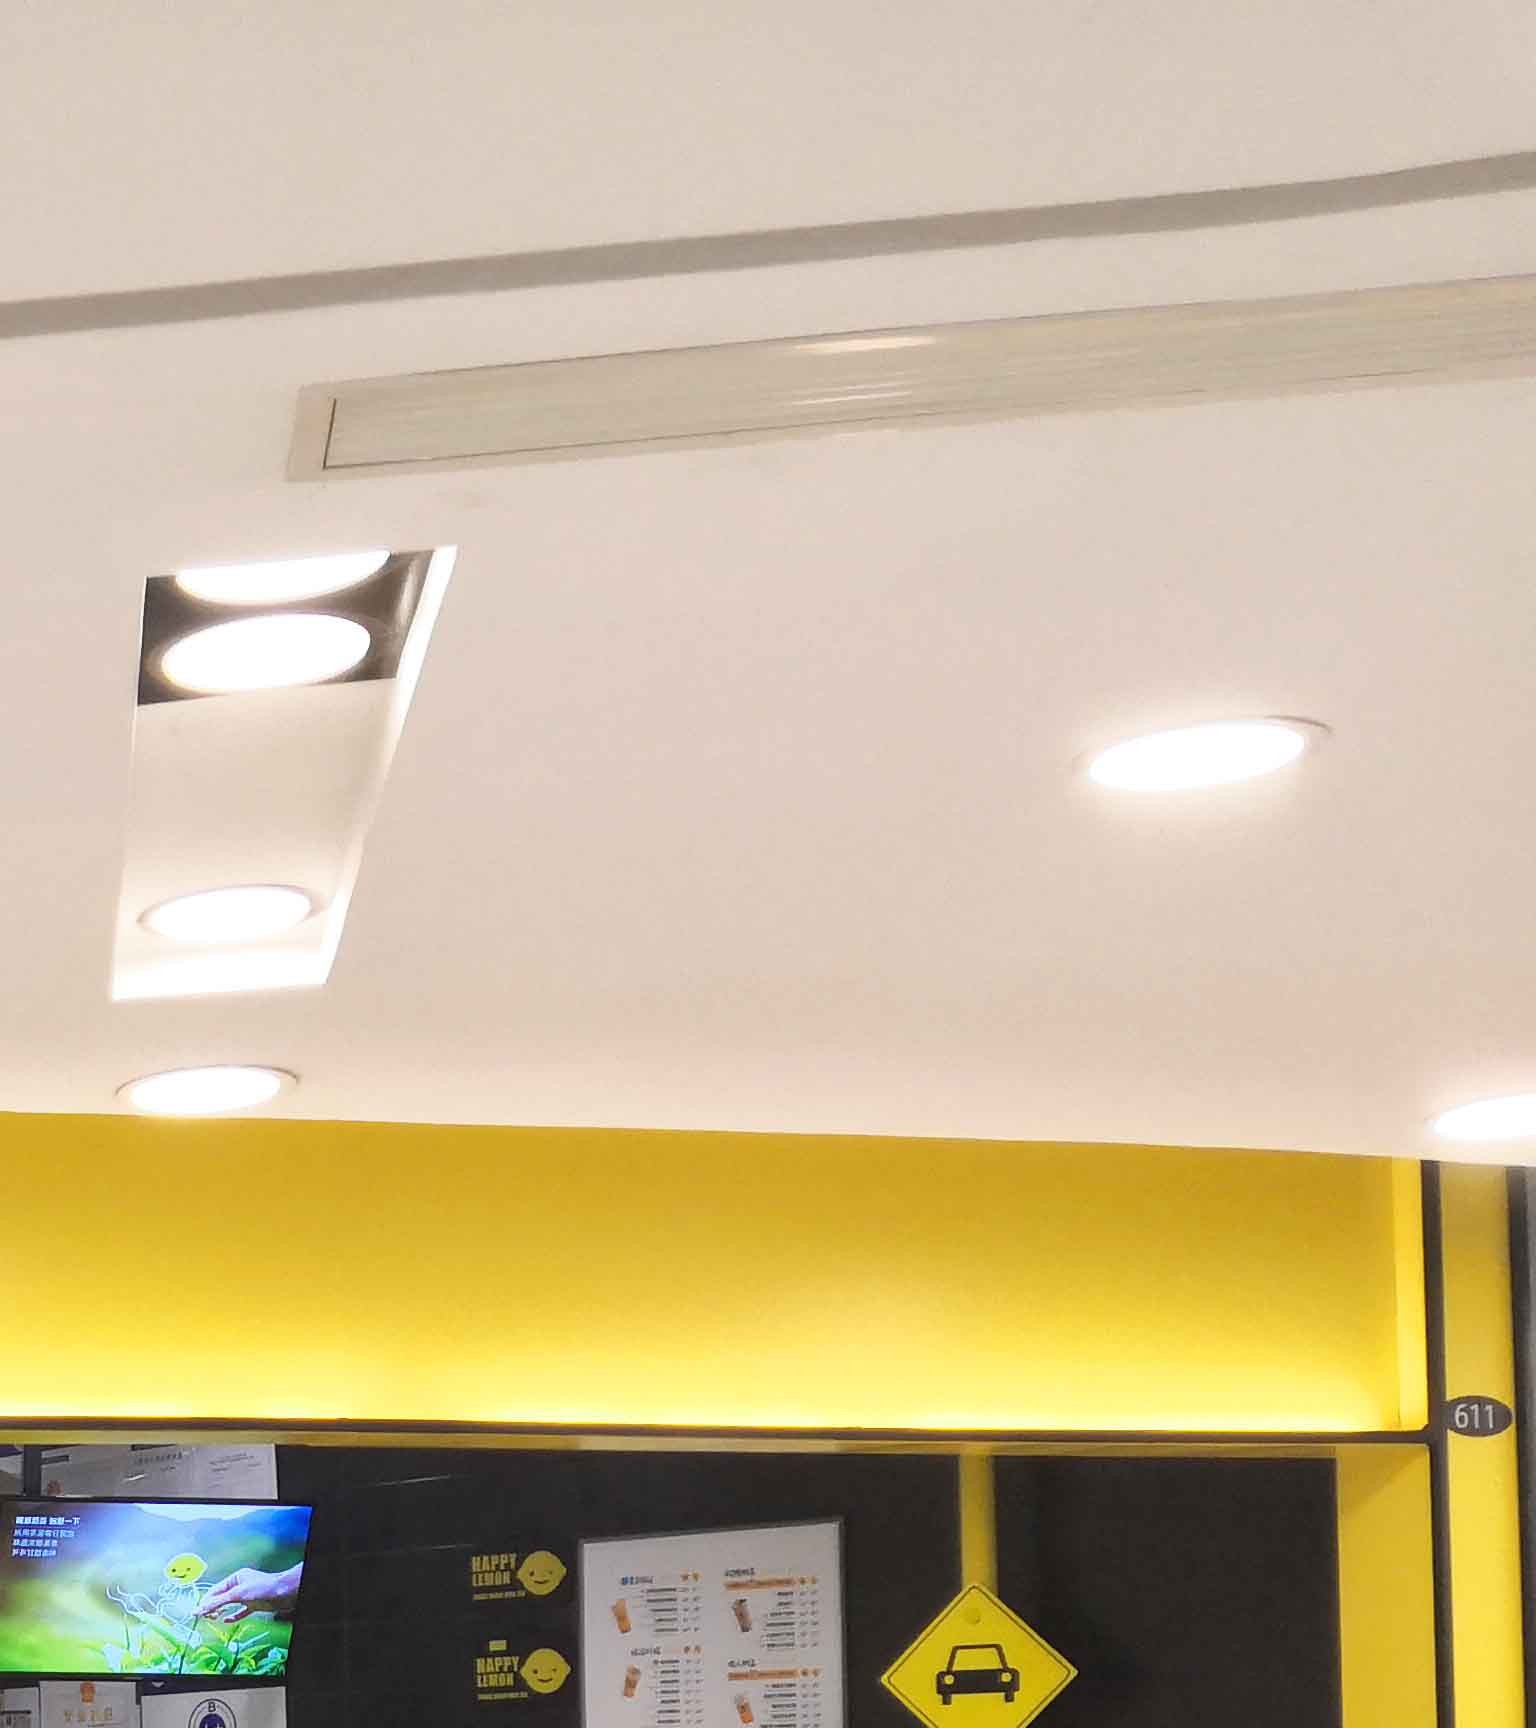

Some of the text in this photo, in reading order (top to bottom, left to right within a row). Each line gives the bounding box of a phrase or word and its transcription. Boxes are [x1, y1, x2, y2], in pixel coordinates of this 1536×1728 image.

[1454, 1403, 1495, 1429] 611
[471, 1552, 517, 1572] HAPPY
[471, 1570, 512, 1588] LEMON
[475, 1657, 520, 1675] HAPPY
[476, 1673, 515, 1688] LEMON
